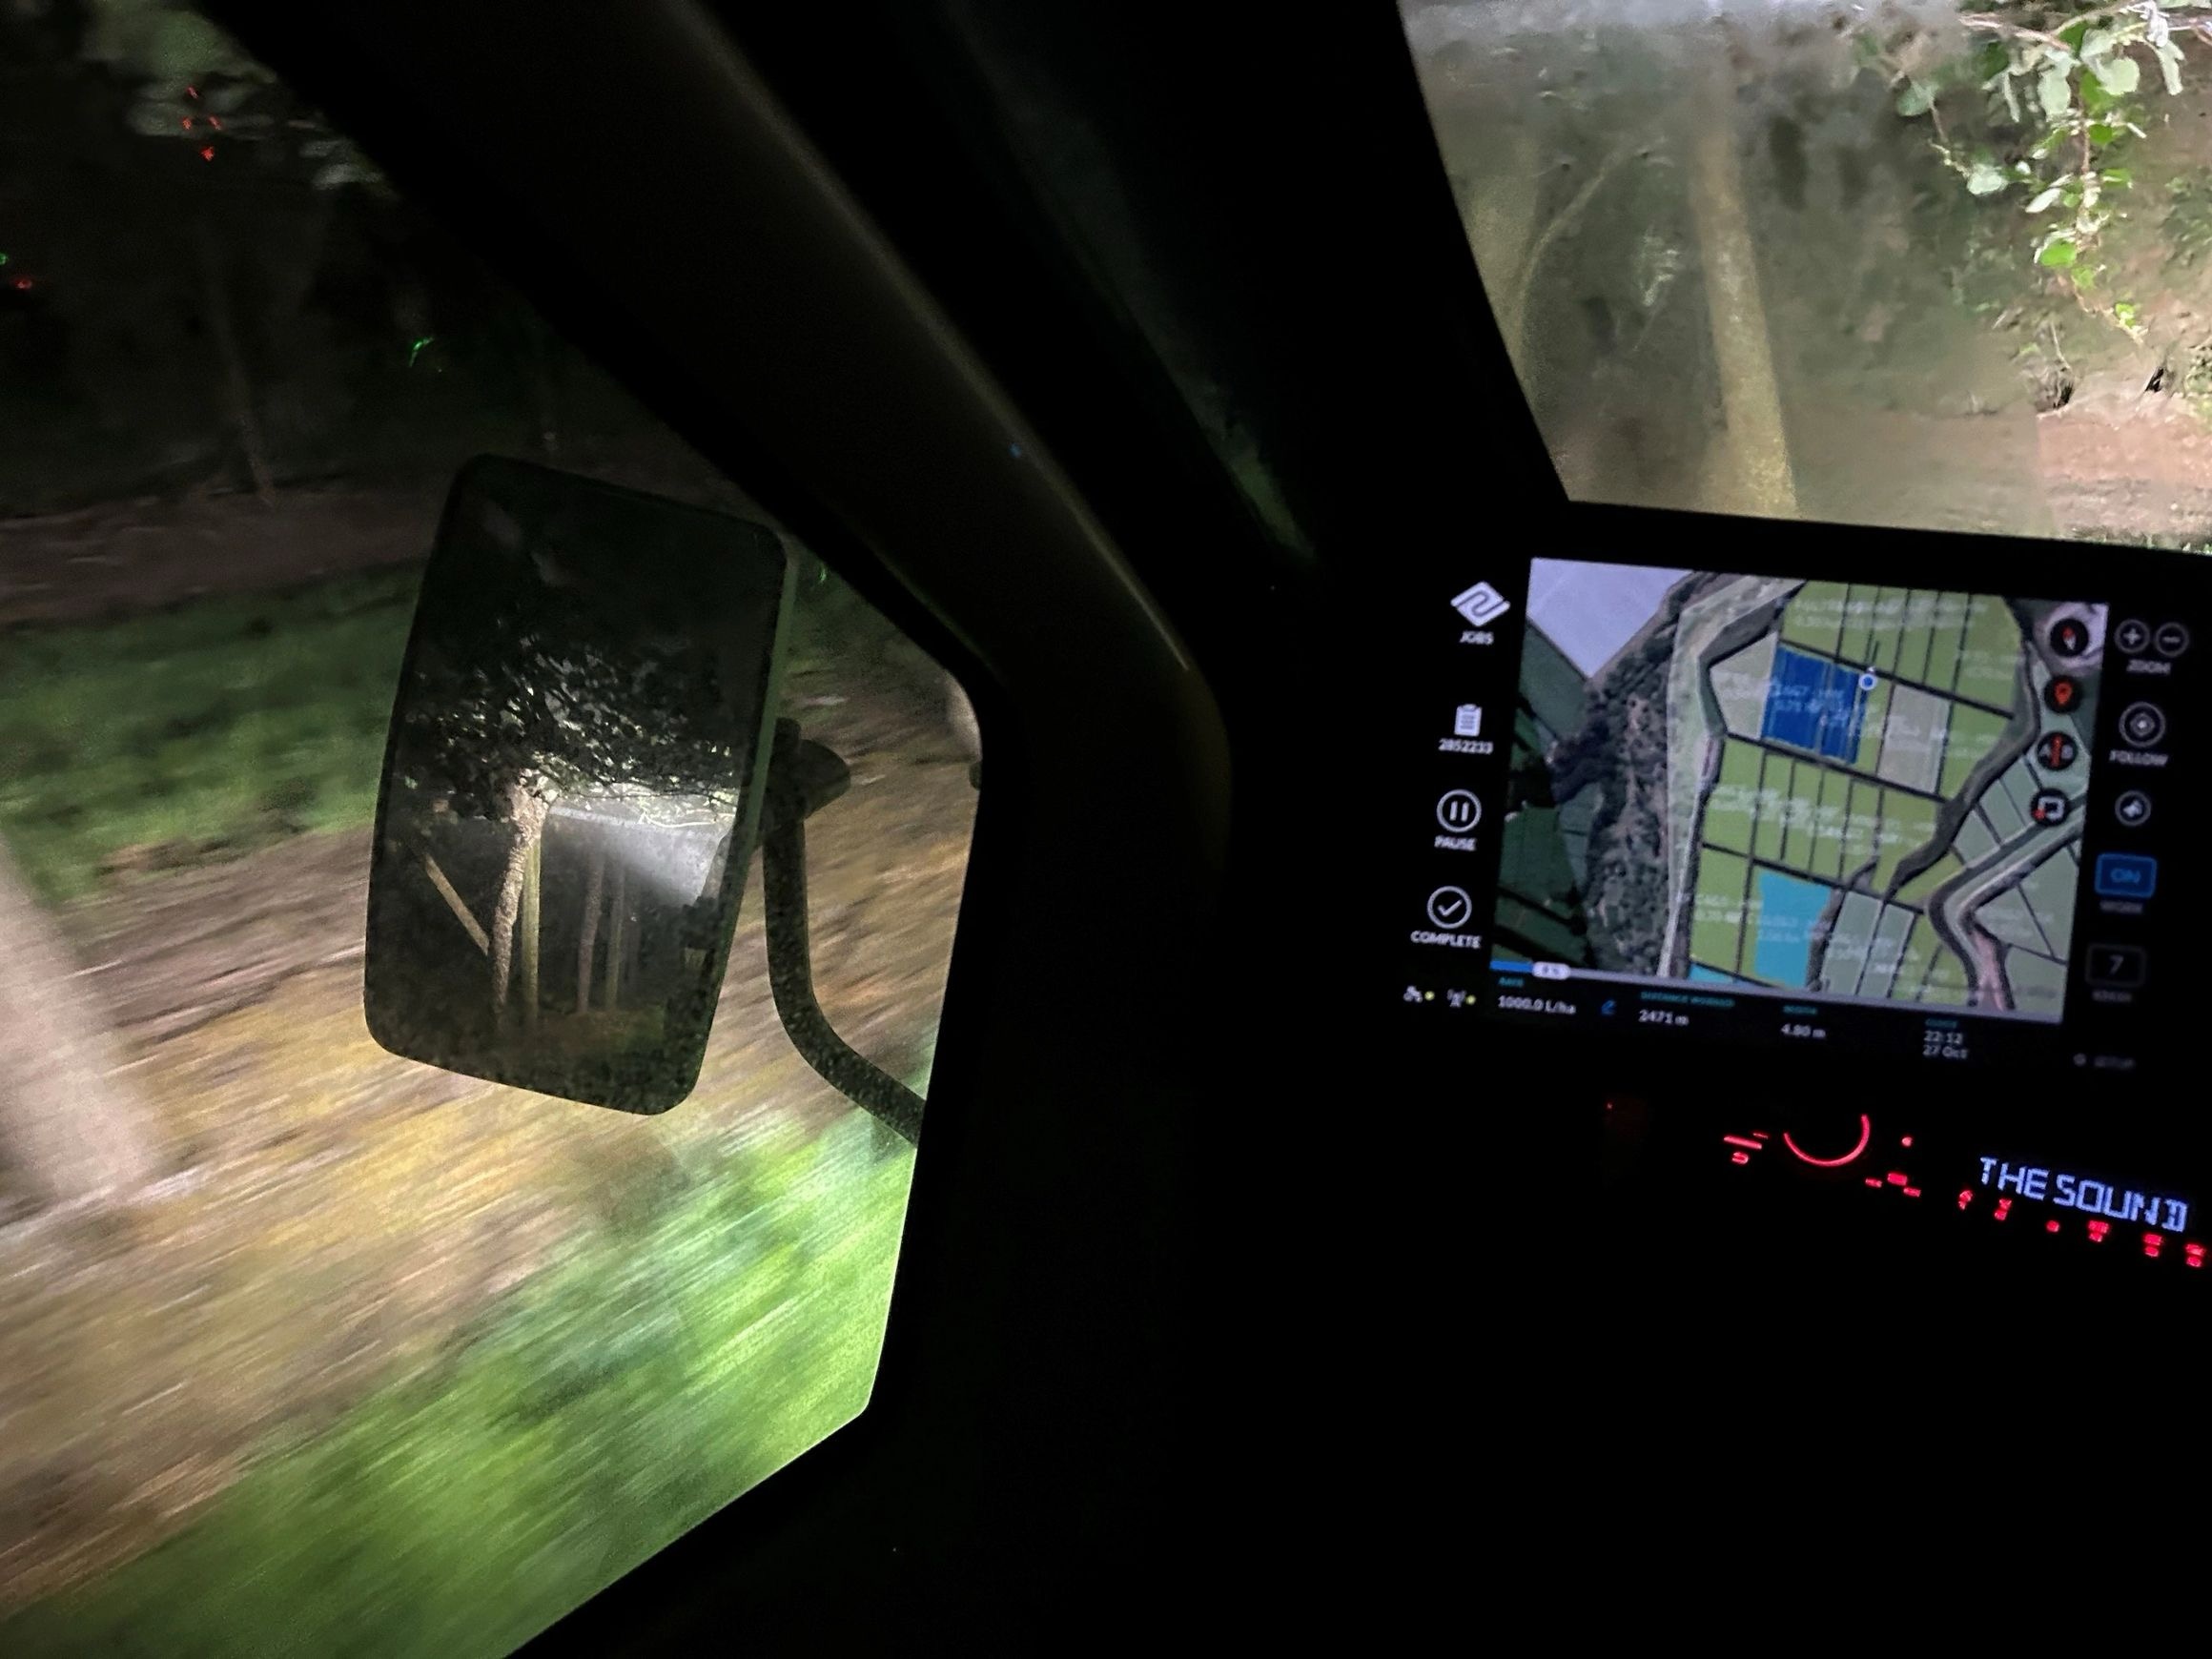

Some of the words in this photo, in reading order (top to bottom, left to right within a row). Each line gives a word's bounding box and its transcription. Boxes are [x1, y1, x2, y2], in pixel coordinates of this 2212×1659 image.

[1460, 631, 1494, 645] JOBS
[1435, 836, 1477, 850] PAUSE
[2110, 867, 2141, 884] ON
[1411, 931, 1481, 949] COMPLETE
[2108, 954, 2124, 974] 7
[1498, 994, 1543, 1012] 1000.0
[1638, 1009, 1673, 1025] 2471
[1675, 1014, 1690, 1026] m
[1813, 1027, 1827, 1038] m
[1980, 1157, 2049, 1201] THE
[2053, 1174, 2189, 1233] SOUND
